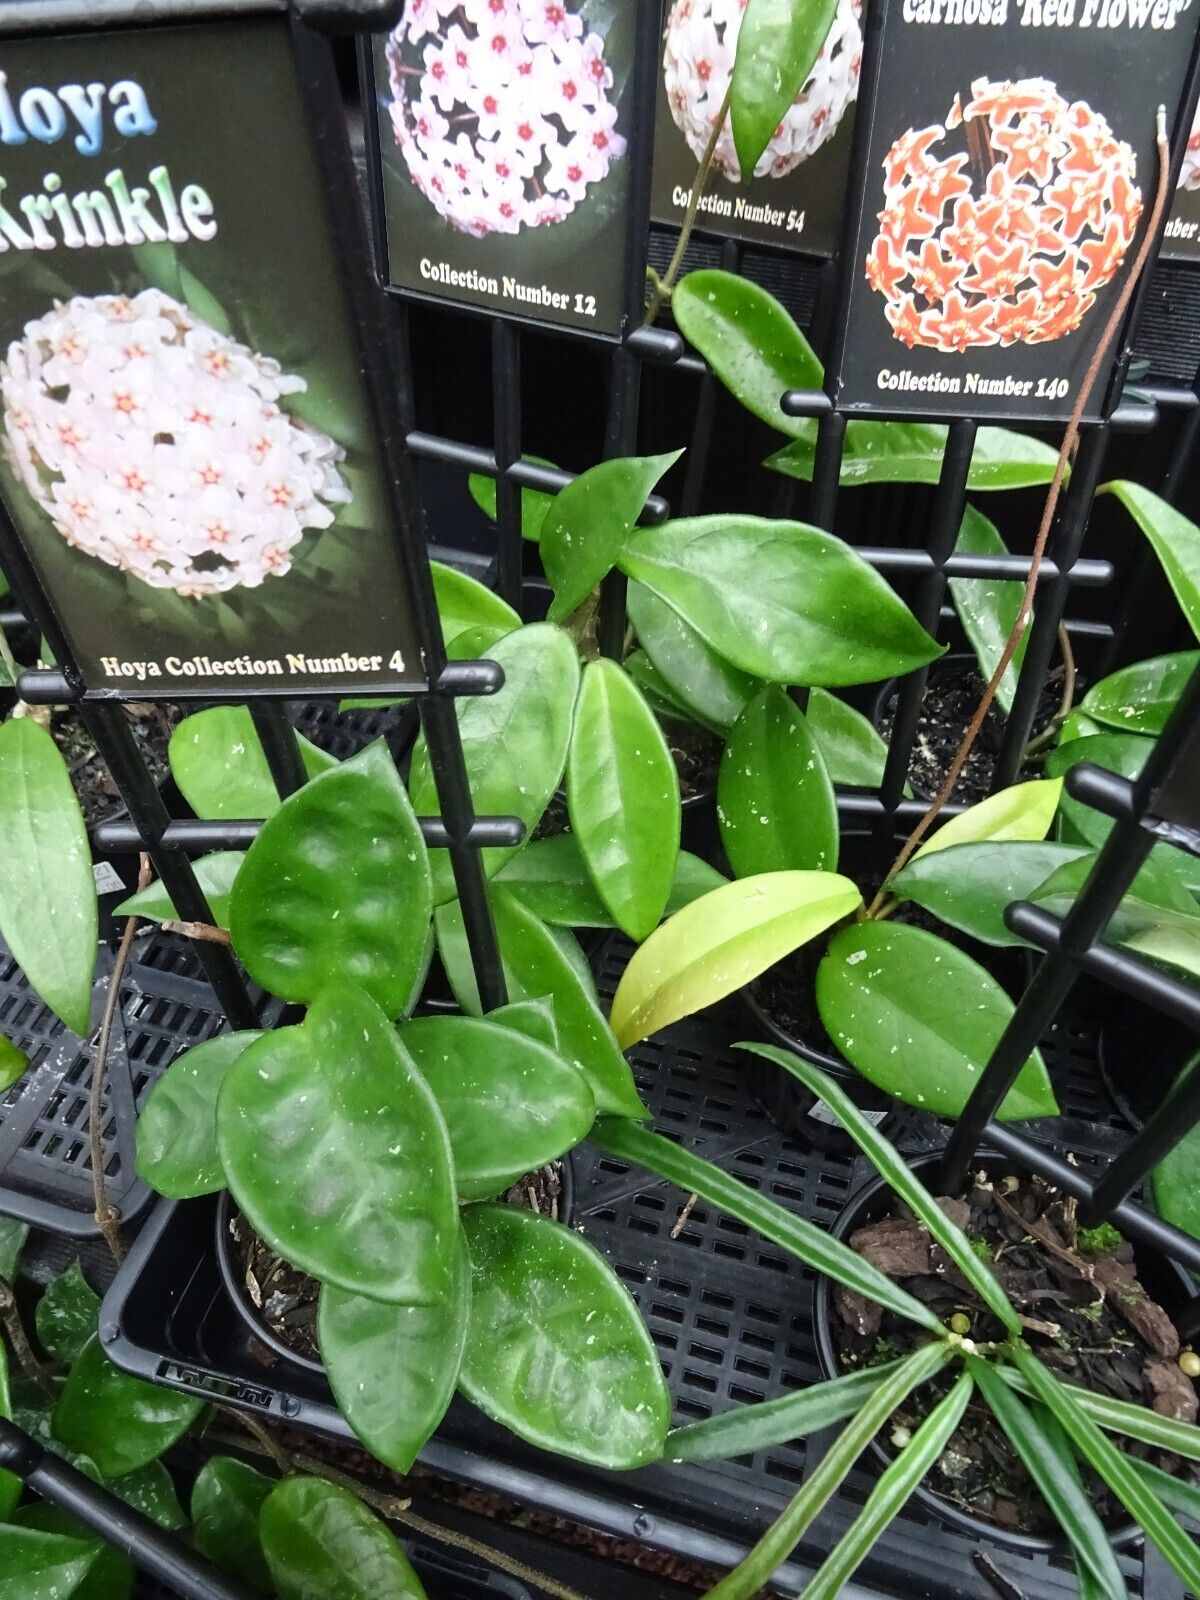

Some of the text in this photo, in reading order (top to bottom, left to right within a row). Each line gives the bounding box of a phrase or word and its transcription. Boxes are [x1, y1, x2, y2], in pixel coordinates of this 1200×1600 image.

[672, 185, 806, 233] Colection Number 54
[420, 257, 597, 317] Collection Number 12
[876, 368, 1069, 400] Collection Number 140
[100, 650, 405, 681] Hoya Collection Number 4
